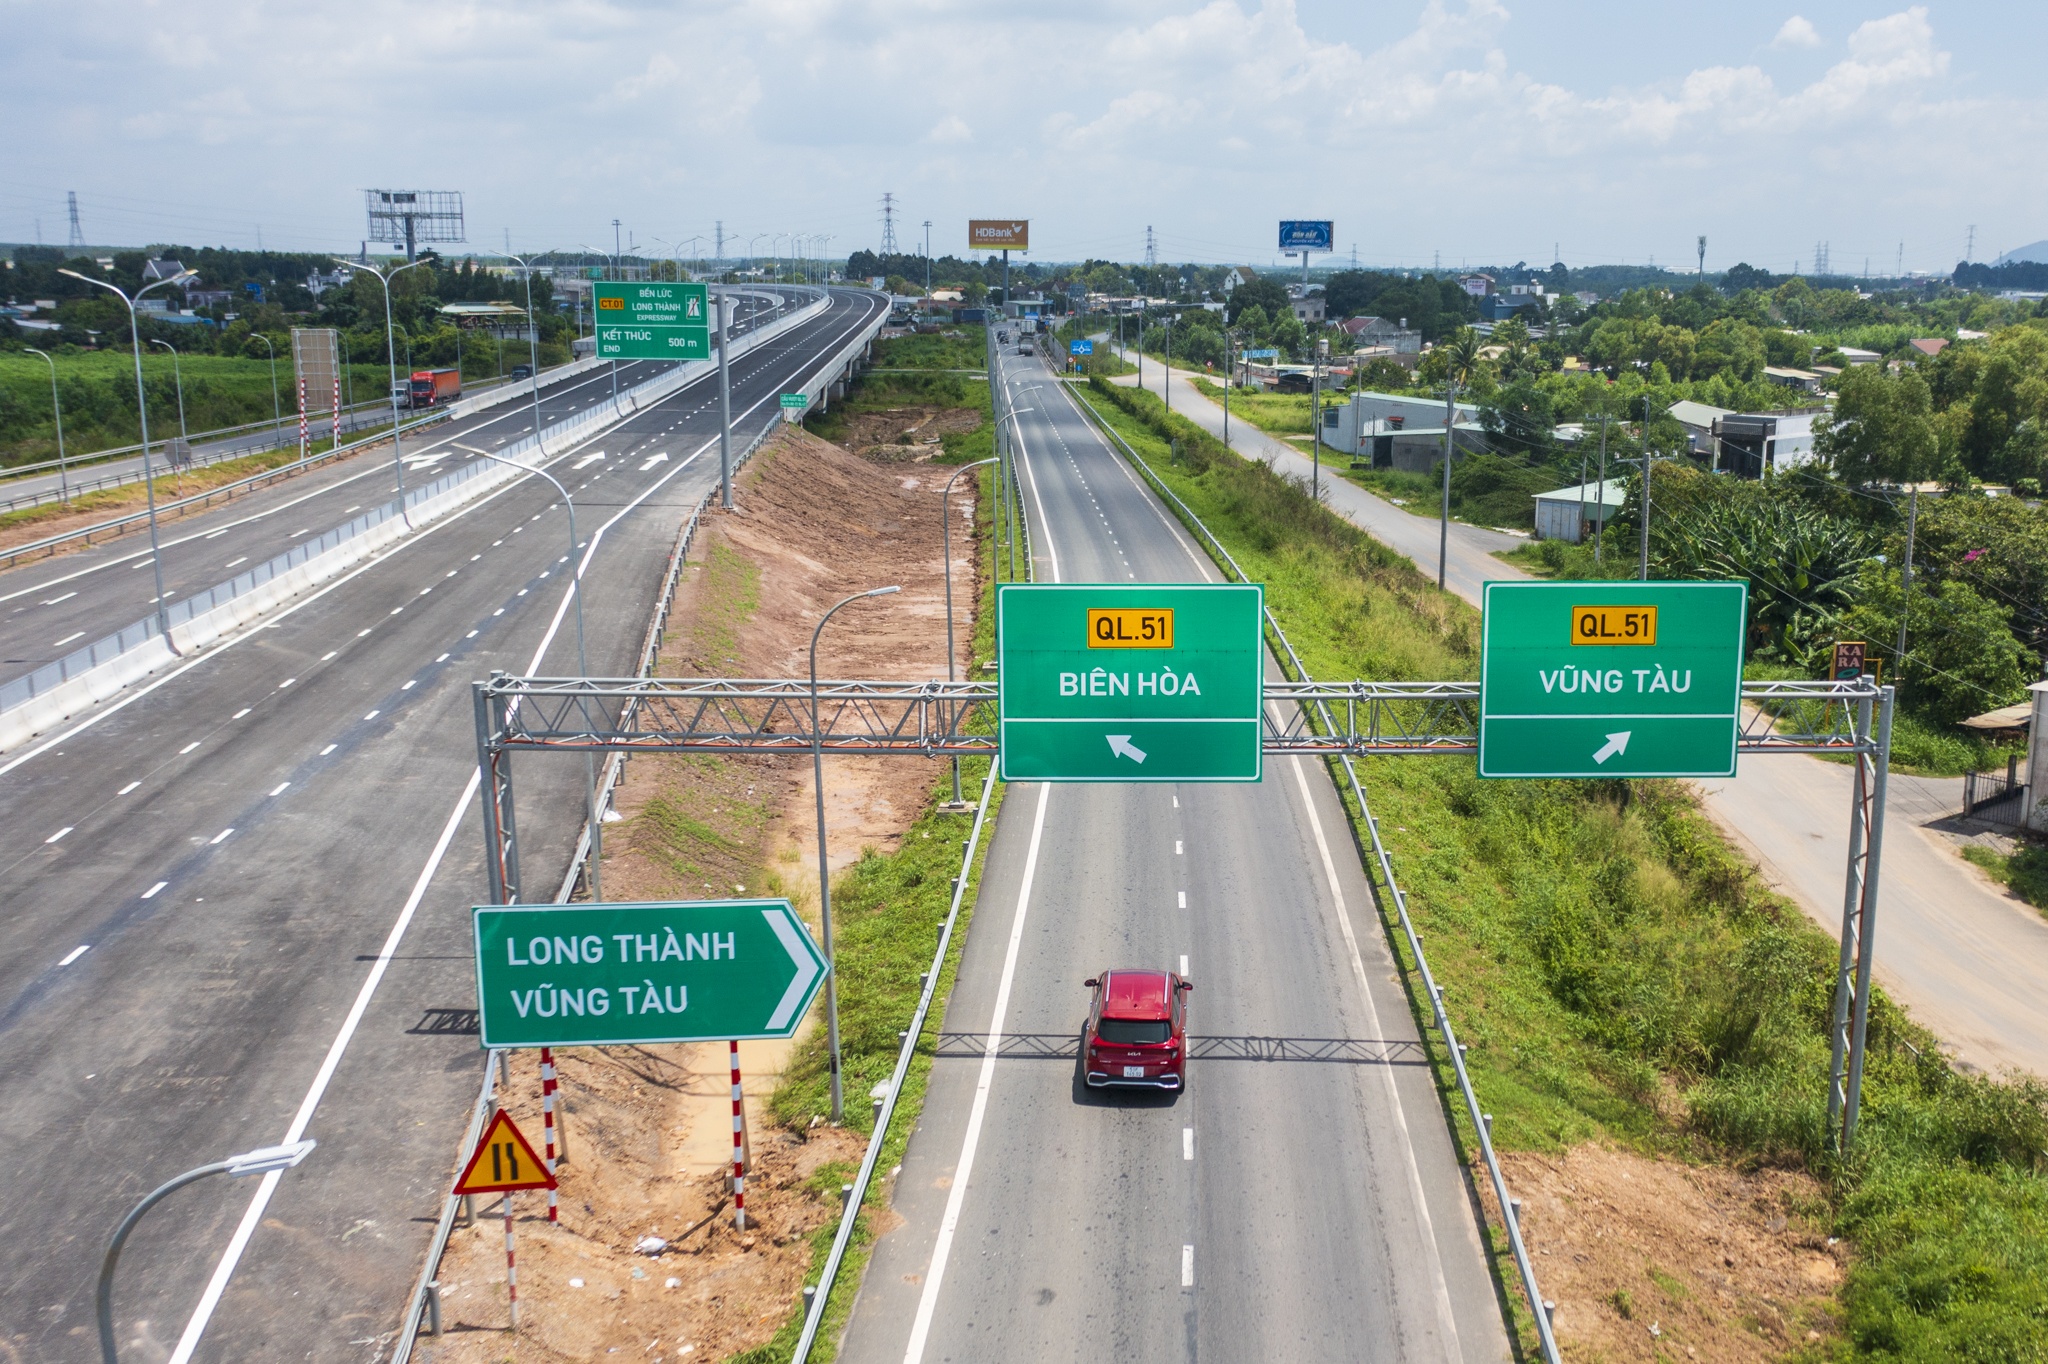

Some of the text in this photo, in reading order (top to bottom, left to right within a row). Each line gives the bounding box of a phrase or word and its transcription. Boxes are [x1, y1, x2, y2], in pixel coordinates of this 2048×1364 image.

[976, 228, 1012, 237] HDBank
[639, 287, 672, 298] BẾN LỨC
[601, 300, 623, 308] CT.01
[632, 301, 681, 311] LONG THÀNH
[602, 328, 651, 341] KẾT THÚC
[668, 338, 685, 347] 500
[1096, 616, 1166, 640] QL.51
[1580, 614, 1649, 638] QL.51
[1838, 646, 1862, 656] KA
[1838, 657, 1860, 668] RA
[1060, 666, 1201, 696] BIÊN HÒA
[1539, 664, 1691, 693] VŨNG TÀU
[507, 926, 736, 966] LONG THÀNH
[510, 979, 688, 1018] VŨNG TÀU
